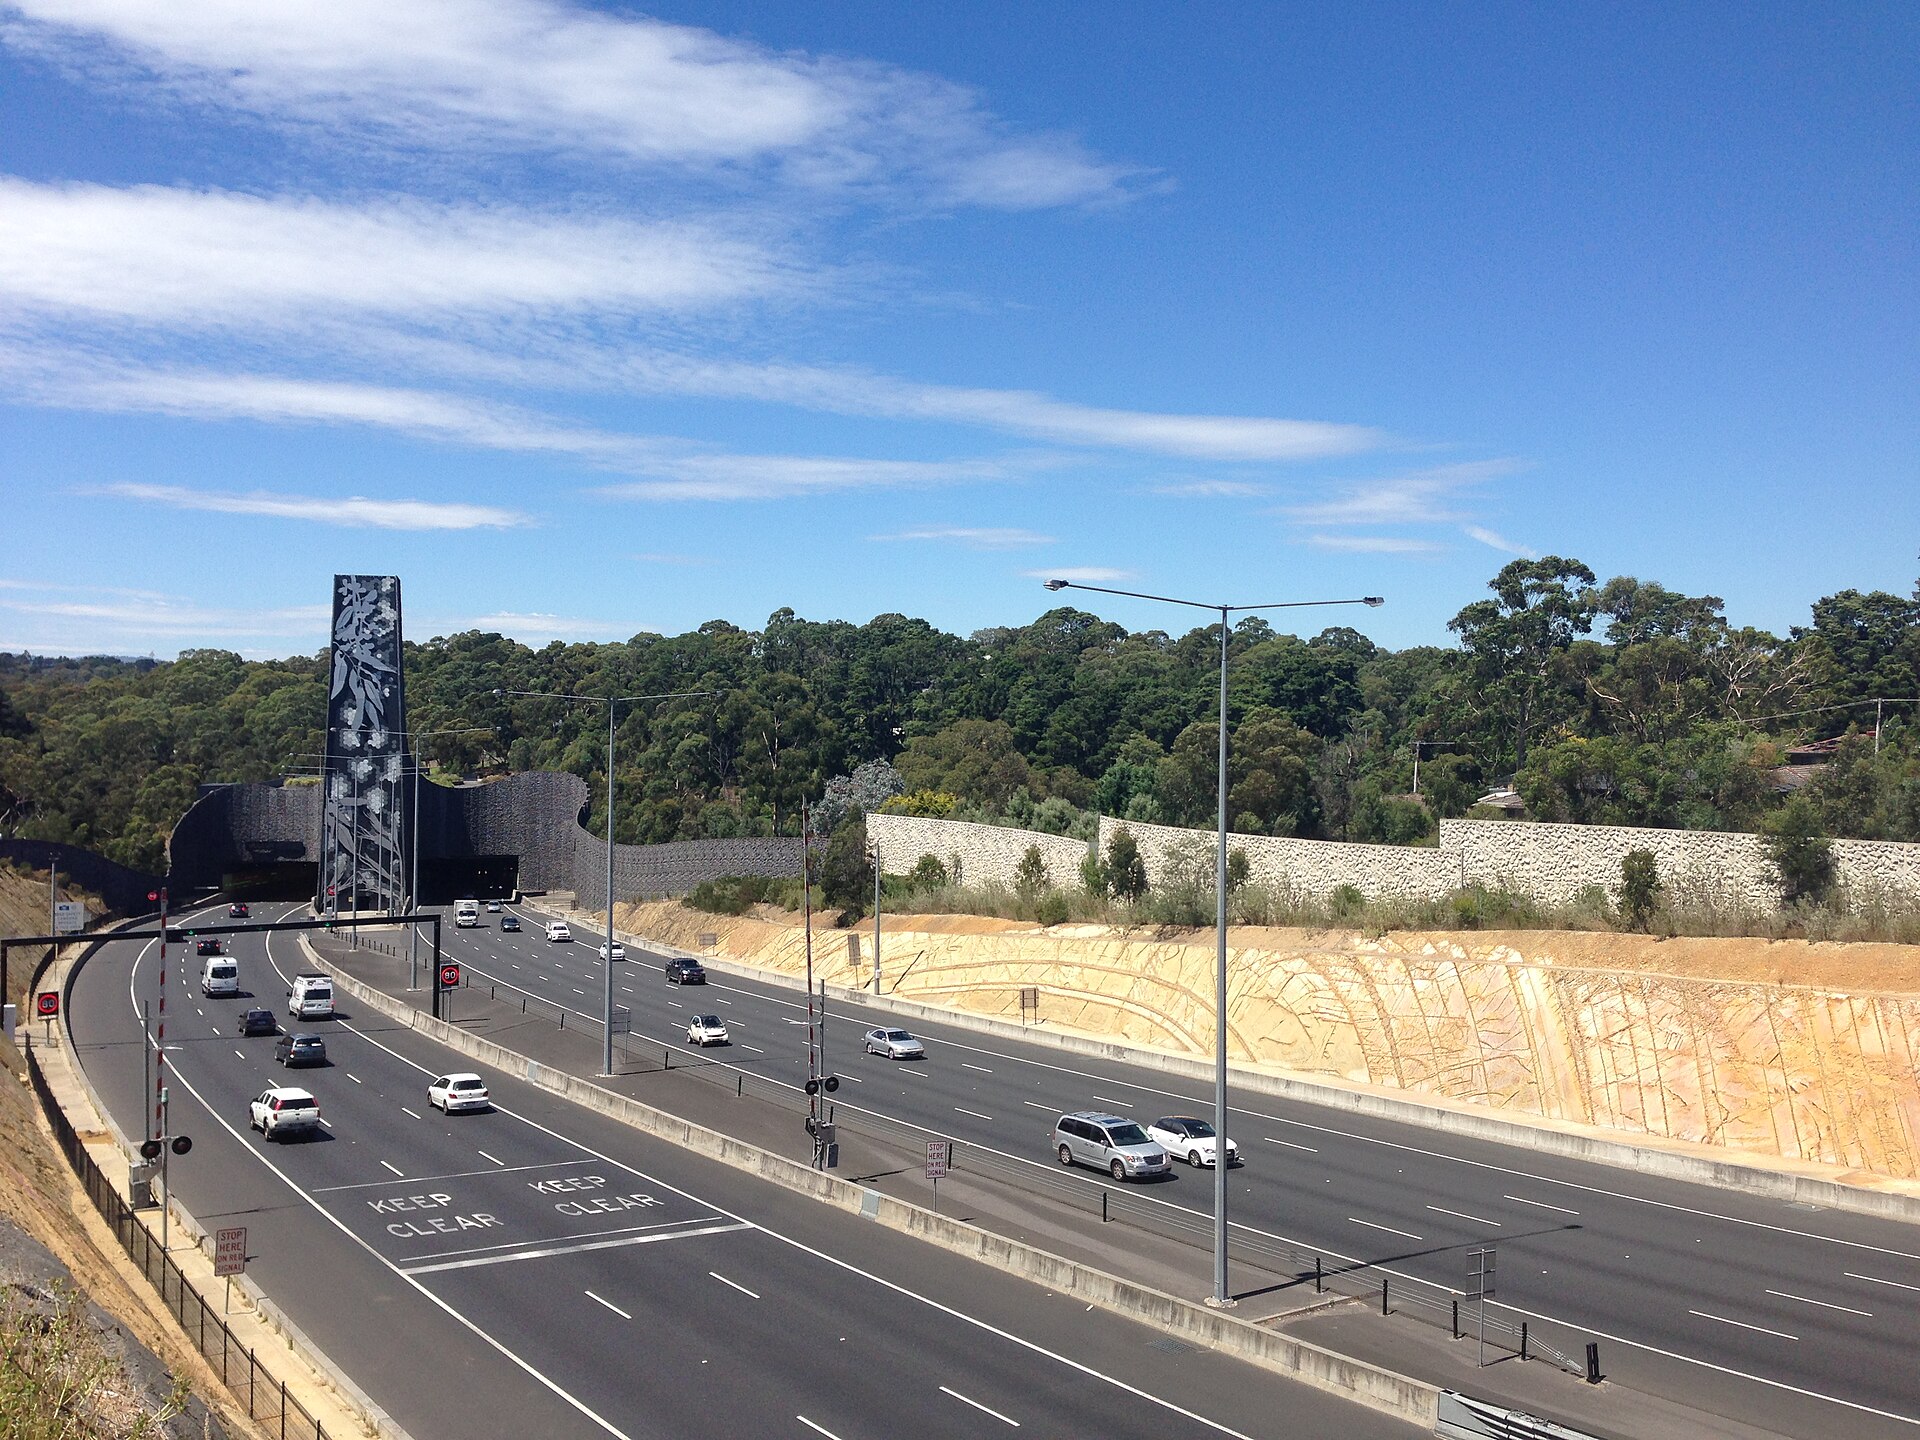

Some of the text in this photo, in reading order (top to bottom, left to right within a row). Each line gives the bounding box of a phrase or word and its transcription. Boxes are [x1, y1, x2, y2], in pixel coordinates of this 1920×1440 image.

[444, 971, 456, 979] 80
[929, 1143, 944, 1151] STOP
[928, 1152, 944, 1160] HERE
[927, 1169, 944, 1177] SIGNAL
[527, 1175, 606, 1194] KEEP
[367, 1193, 452, 1214] KEEP
[554, 1194, 664, 1216] CLEAR
[386, 1213, 504, 1238] CLEAR
[220, 1231, 242, 1241] STOP
[219, 1242, 242, 1252] HERE
[217, 1253, 243, 1263] ON RED
[217, 1263, 241, 1273] SIGNAL
